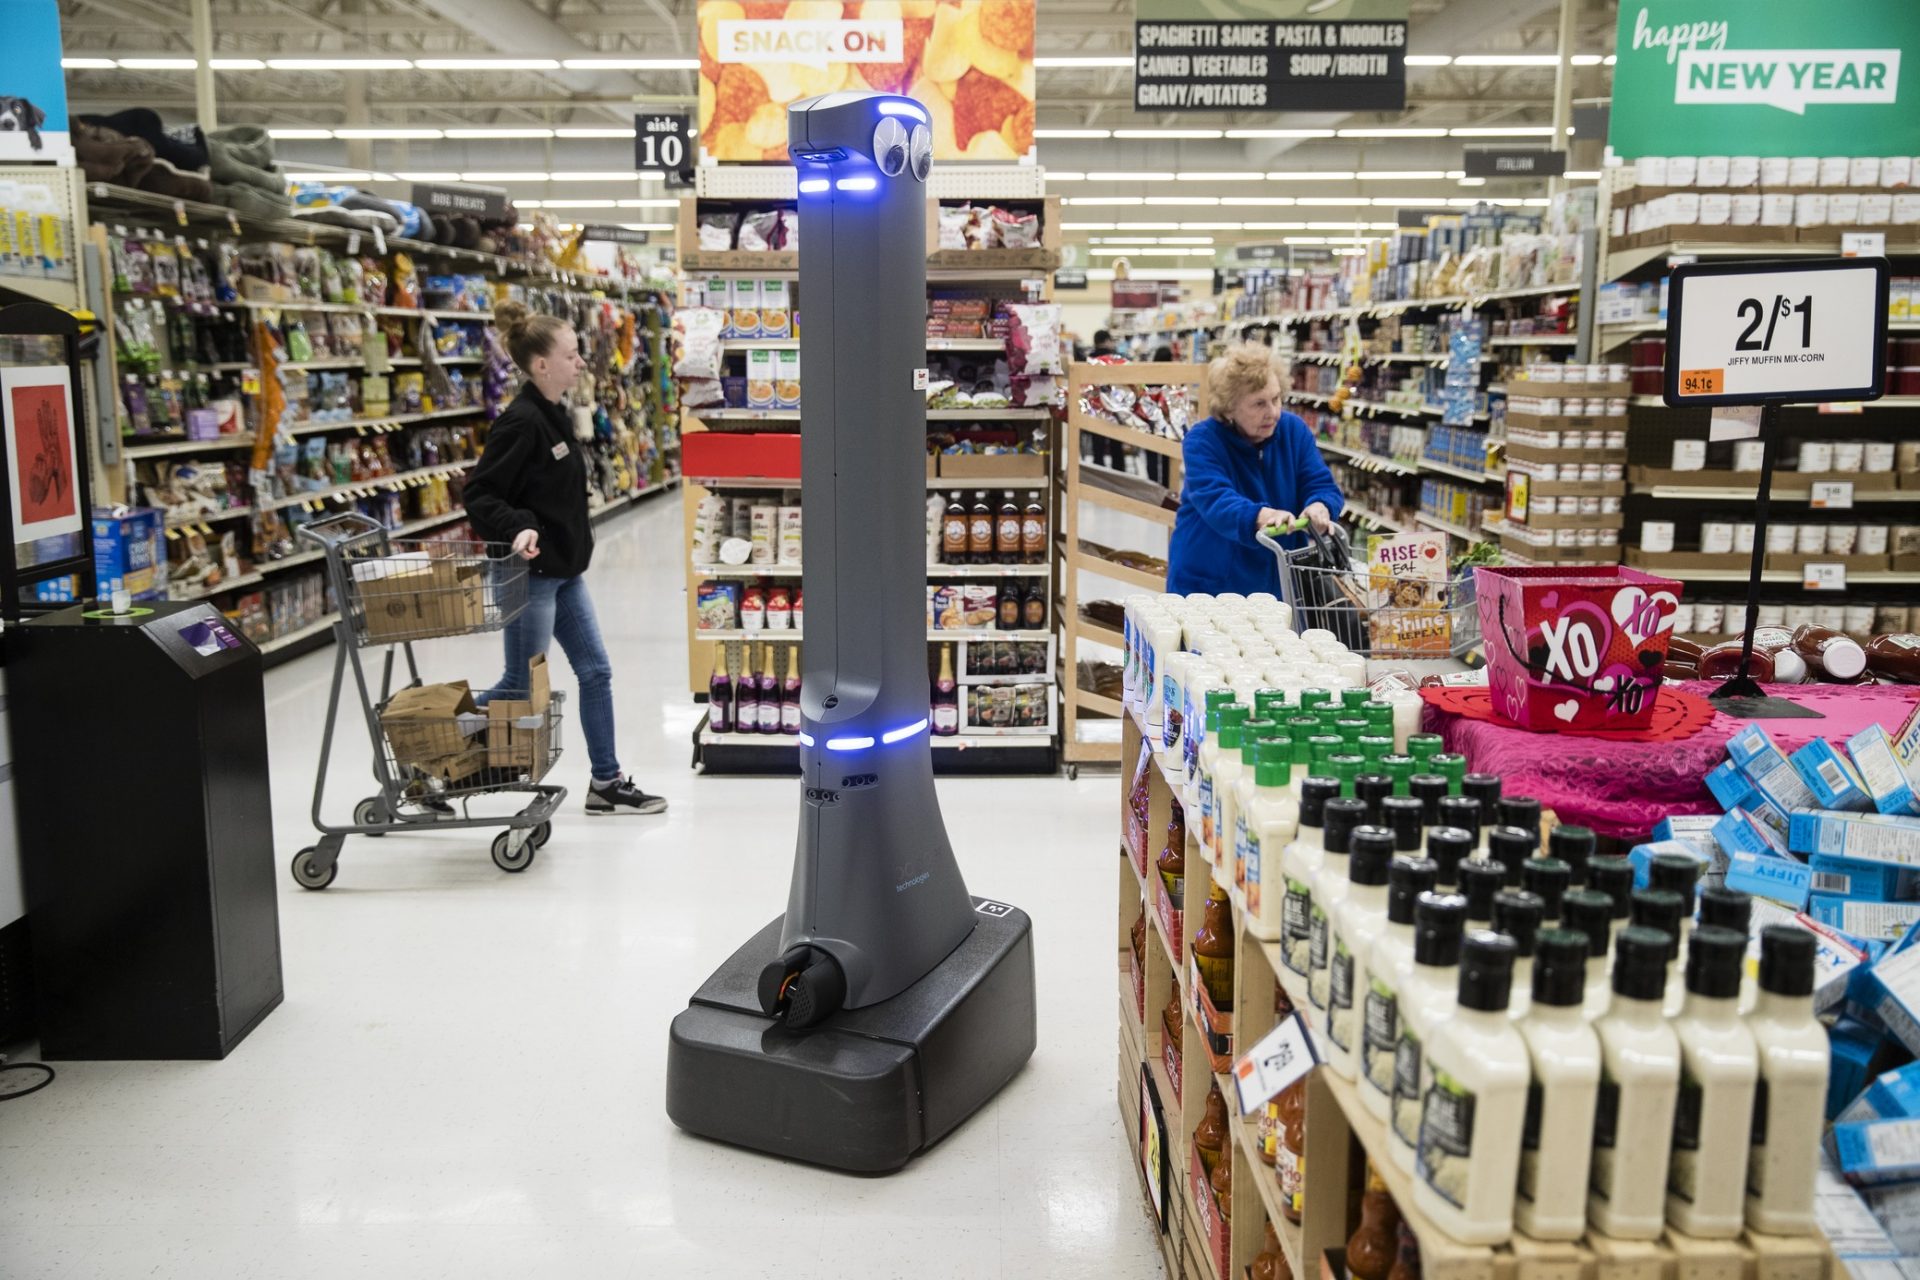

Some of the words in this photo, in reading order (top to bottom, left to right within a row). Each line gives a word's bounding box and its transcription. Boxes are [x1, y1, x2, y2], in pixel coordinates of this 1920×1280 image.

[733, 29, 835, 53] SNACK
[843, 30, 887, 53] ON
[1139, 25, 1218, 47] SPAGHETTI
[1221, 25, 1269, 47] SAUCE
[1275, 25, 1322, 47] PASTA
[1325, 25, 1337, 47] &
[1340, 24, 1406, 47] NOODLES
[1632, 7, 1729, 65] happy
[1138, 54, 1191, 77] CANNED
[1192, 54, 1268, 77] VEGETABLES
[1289, 53, 1389, 78] SOUP/BROTH
[1688, 62, 1778, 90] NEW
[1787, 62, 1888, 90] YEAR
[1137, 83, 1268, 108] GRAVY/POTATOES
[646, 115, 679, 133] aisle
[641, 134, 684, 168] 10
[1495, 156, 1536, 172] ITALIAN
[453, 193, 487, 212] TREATS
[1735, 294, 1813, 351] 2/$1
[1727, 355, 1750, 367] JIFFY
[1751, 354, 1783, 365] MUFFIN
[1784, 353, 1825, 364] MIX-CORN
[1380, 544, 1418, 563] RISE
[1392, 561, 1417, 576] Eat
[1620, 594, 1662, 638] XO
[1397, 627, 1445, 642] REPEAT
[1539, 616, 1600, 686] XO
[1605, 673, 1645, 716] XO
[895, 871, 930, 893] technologies
[1756, 864, 1807, 887] JIFFY
